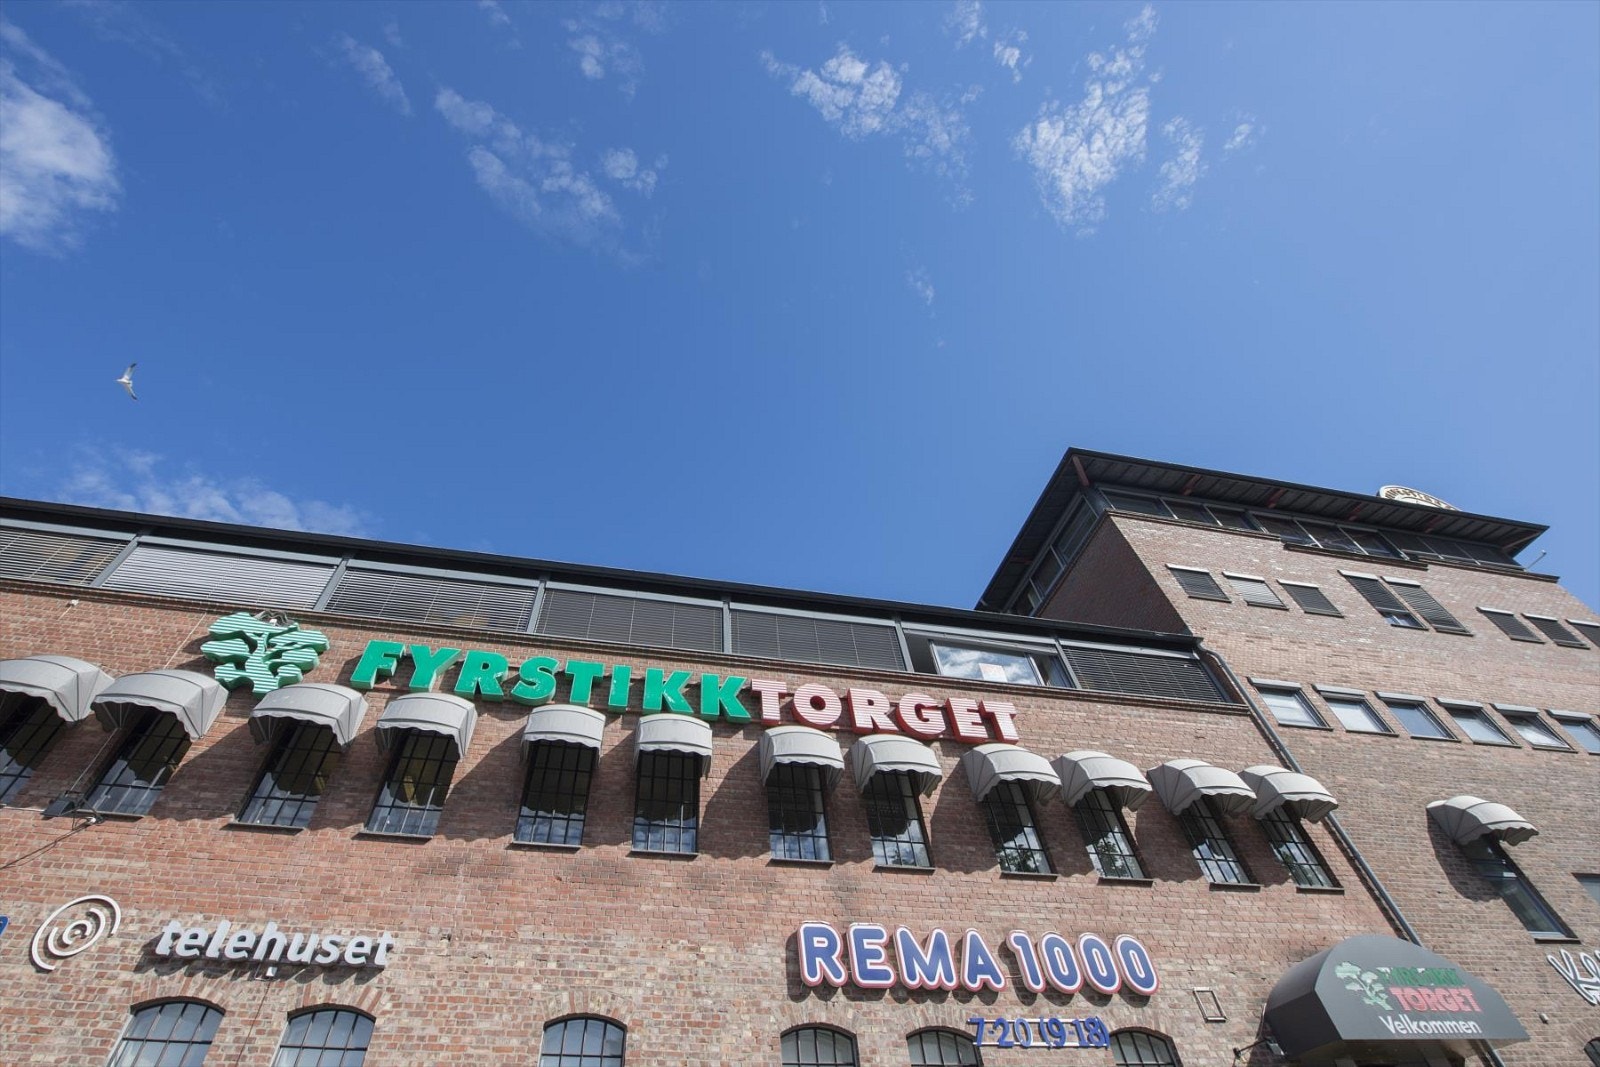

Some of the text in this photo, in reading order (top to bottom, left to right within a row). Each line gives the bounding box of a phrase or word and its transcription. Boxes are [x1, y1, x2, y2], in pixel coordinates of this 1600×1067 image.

[155, 919, 394, 967] telehuset
[796, 920, 1160, 996] REMA 1000
[1389, 987, 1483, 1012] TORGET
[969, 1016, 1110, 1050] 7-20 (9-18)
[1378, 1013, 1482, 1035] Velkommen
